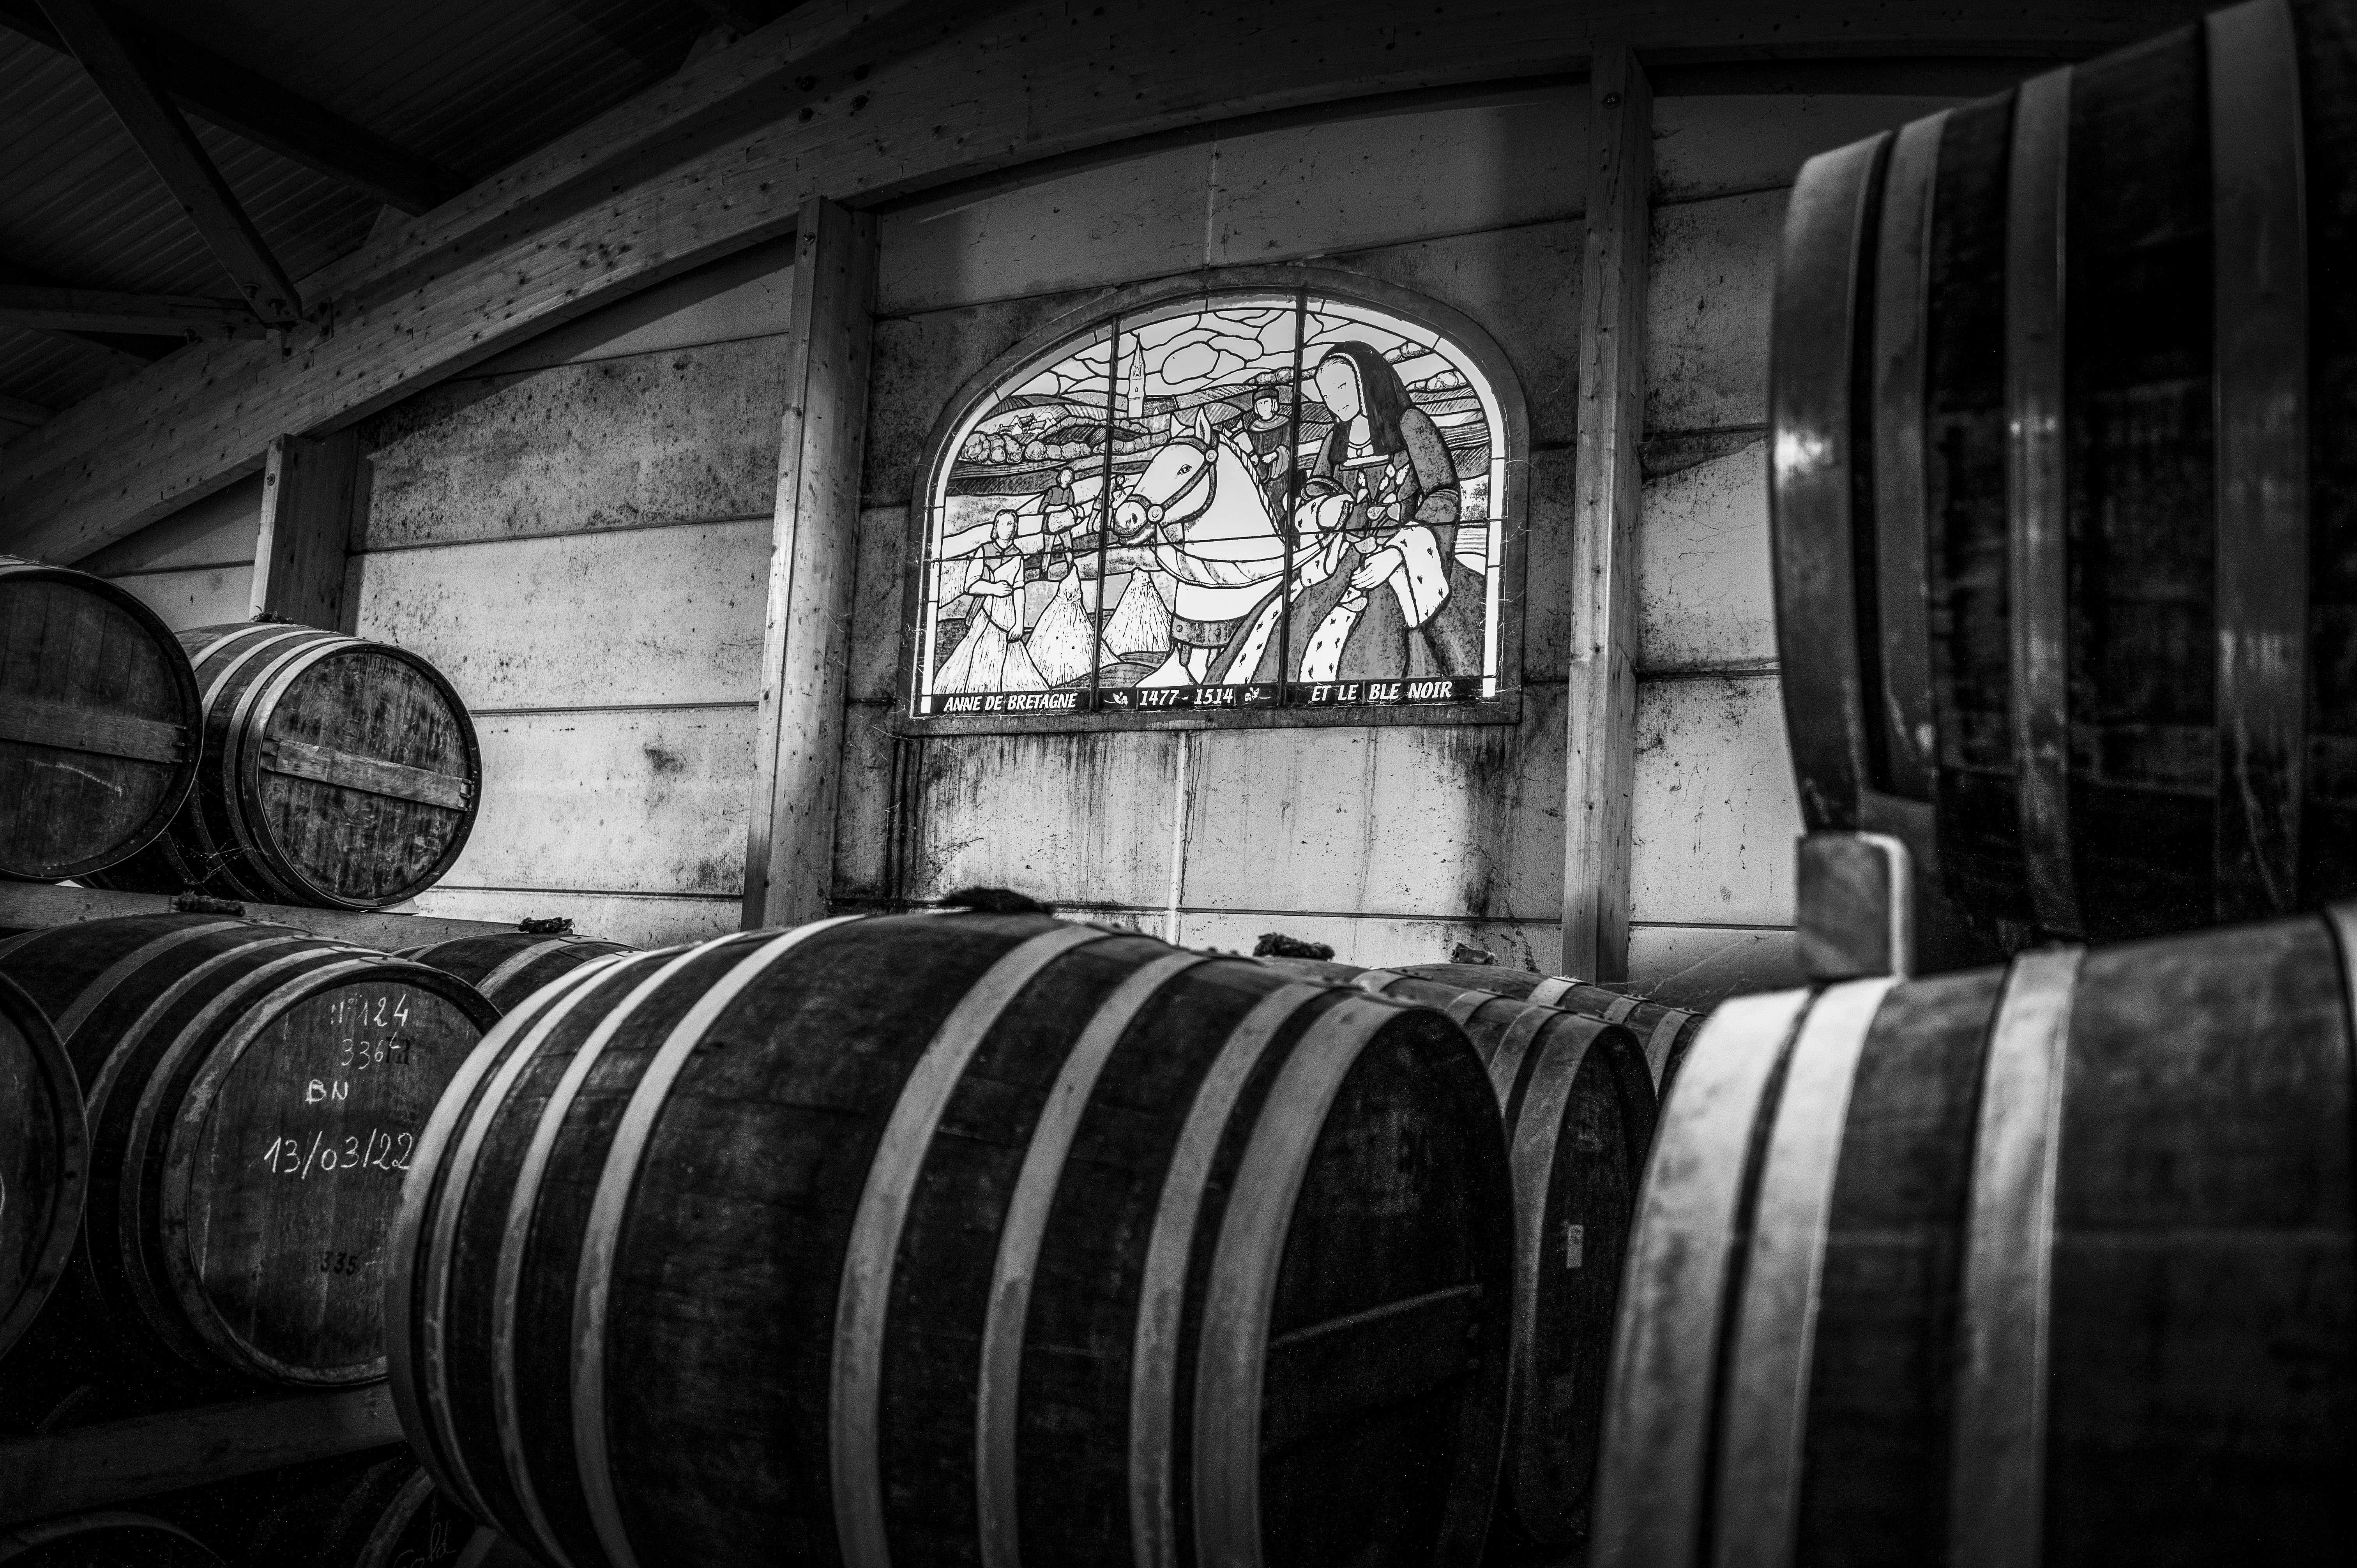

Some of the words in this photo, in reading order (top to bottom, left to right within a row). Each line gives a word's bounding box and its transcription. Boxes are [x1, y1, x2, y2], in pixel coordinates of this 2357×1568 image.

[944, 696, 982, 712] ANNE
[984, 696, 1004, 710] DE
[1007, 693, 1078, 710] BRETAGNE
[1140, 689, 1180, 706] 1477
[1194, 688, 1233, 705] 1514
[1312, 685, 1331, 701] ET
[1338, 684, 1359, 701] LE
[1369, 683, 1401, 700] BLE
[1408, 681, 1452, 699] NOIR
[264, 1128, 413, 1180] 13/03/22
[320, 1252, 358, 1275] 335
